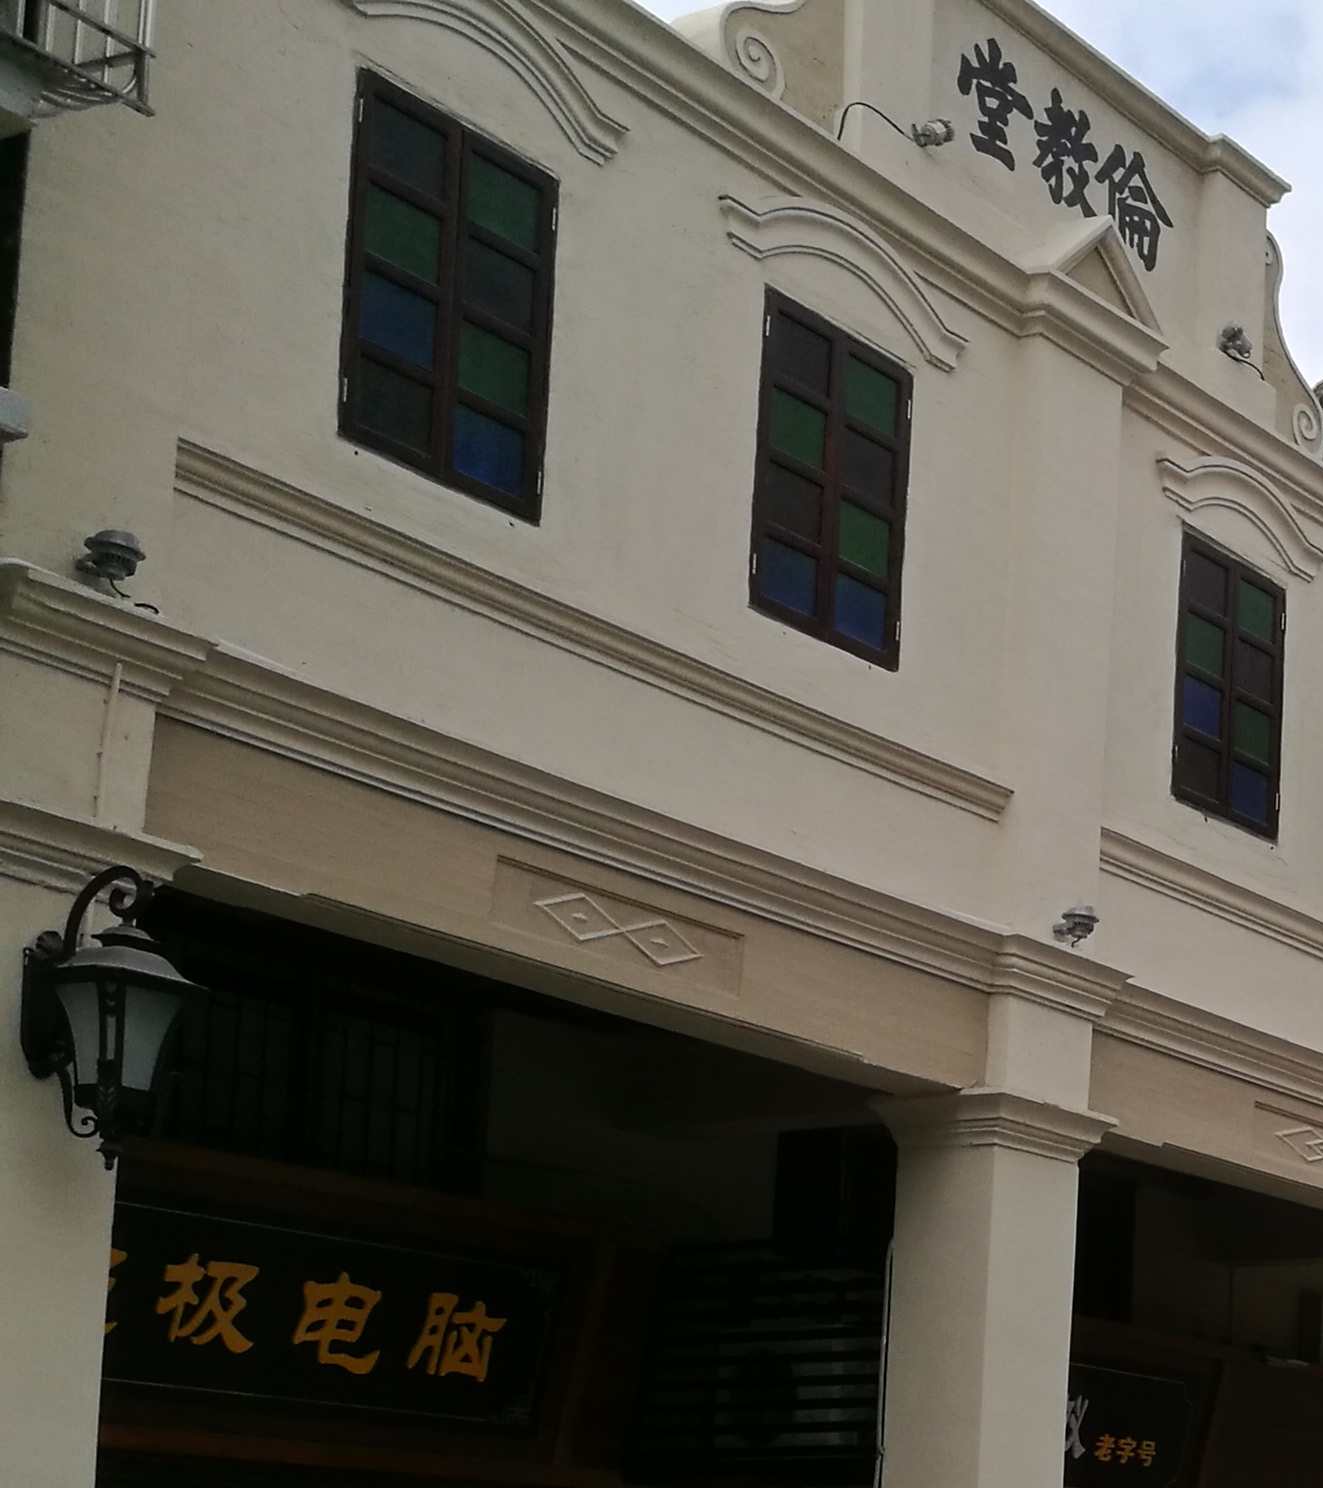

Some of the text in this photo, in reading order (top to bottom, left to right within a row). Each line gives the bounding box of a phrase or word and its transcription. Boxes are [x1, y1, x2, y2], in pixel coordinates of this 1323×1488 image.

[104, 1247, 507, 1383] 极电脑
[1093, 1433, 1157, 1468] 老字号
